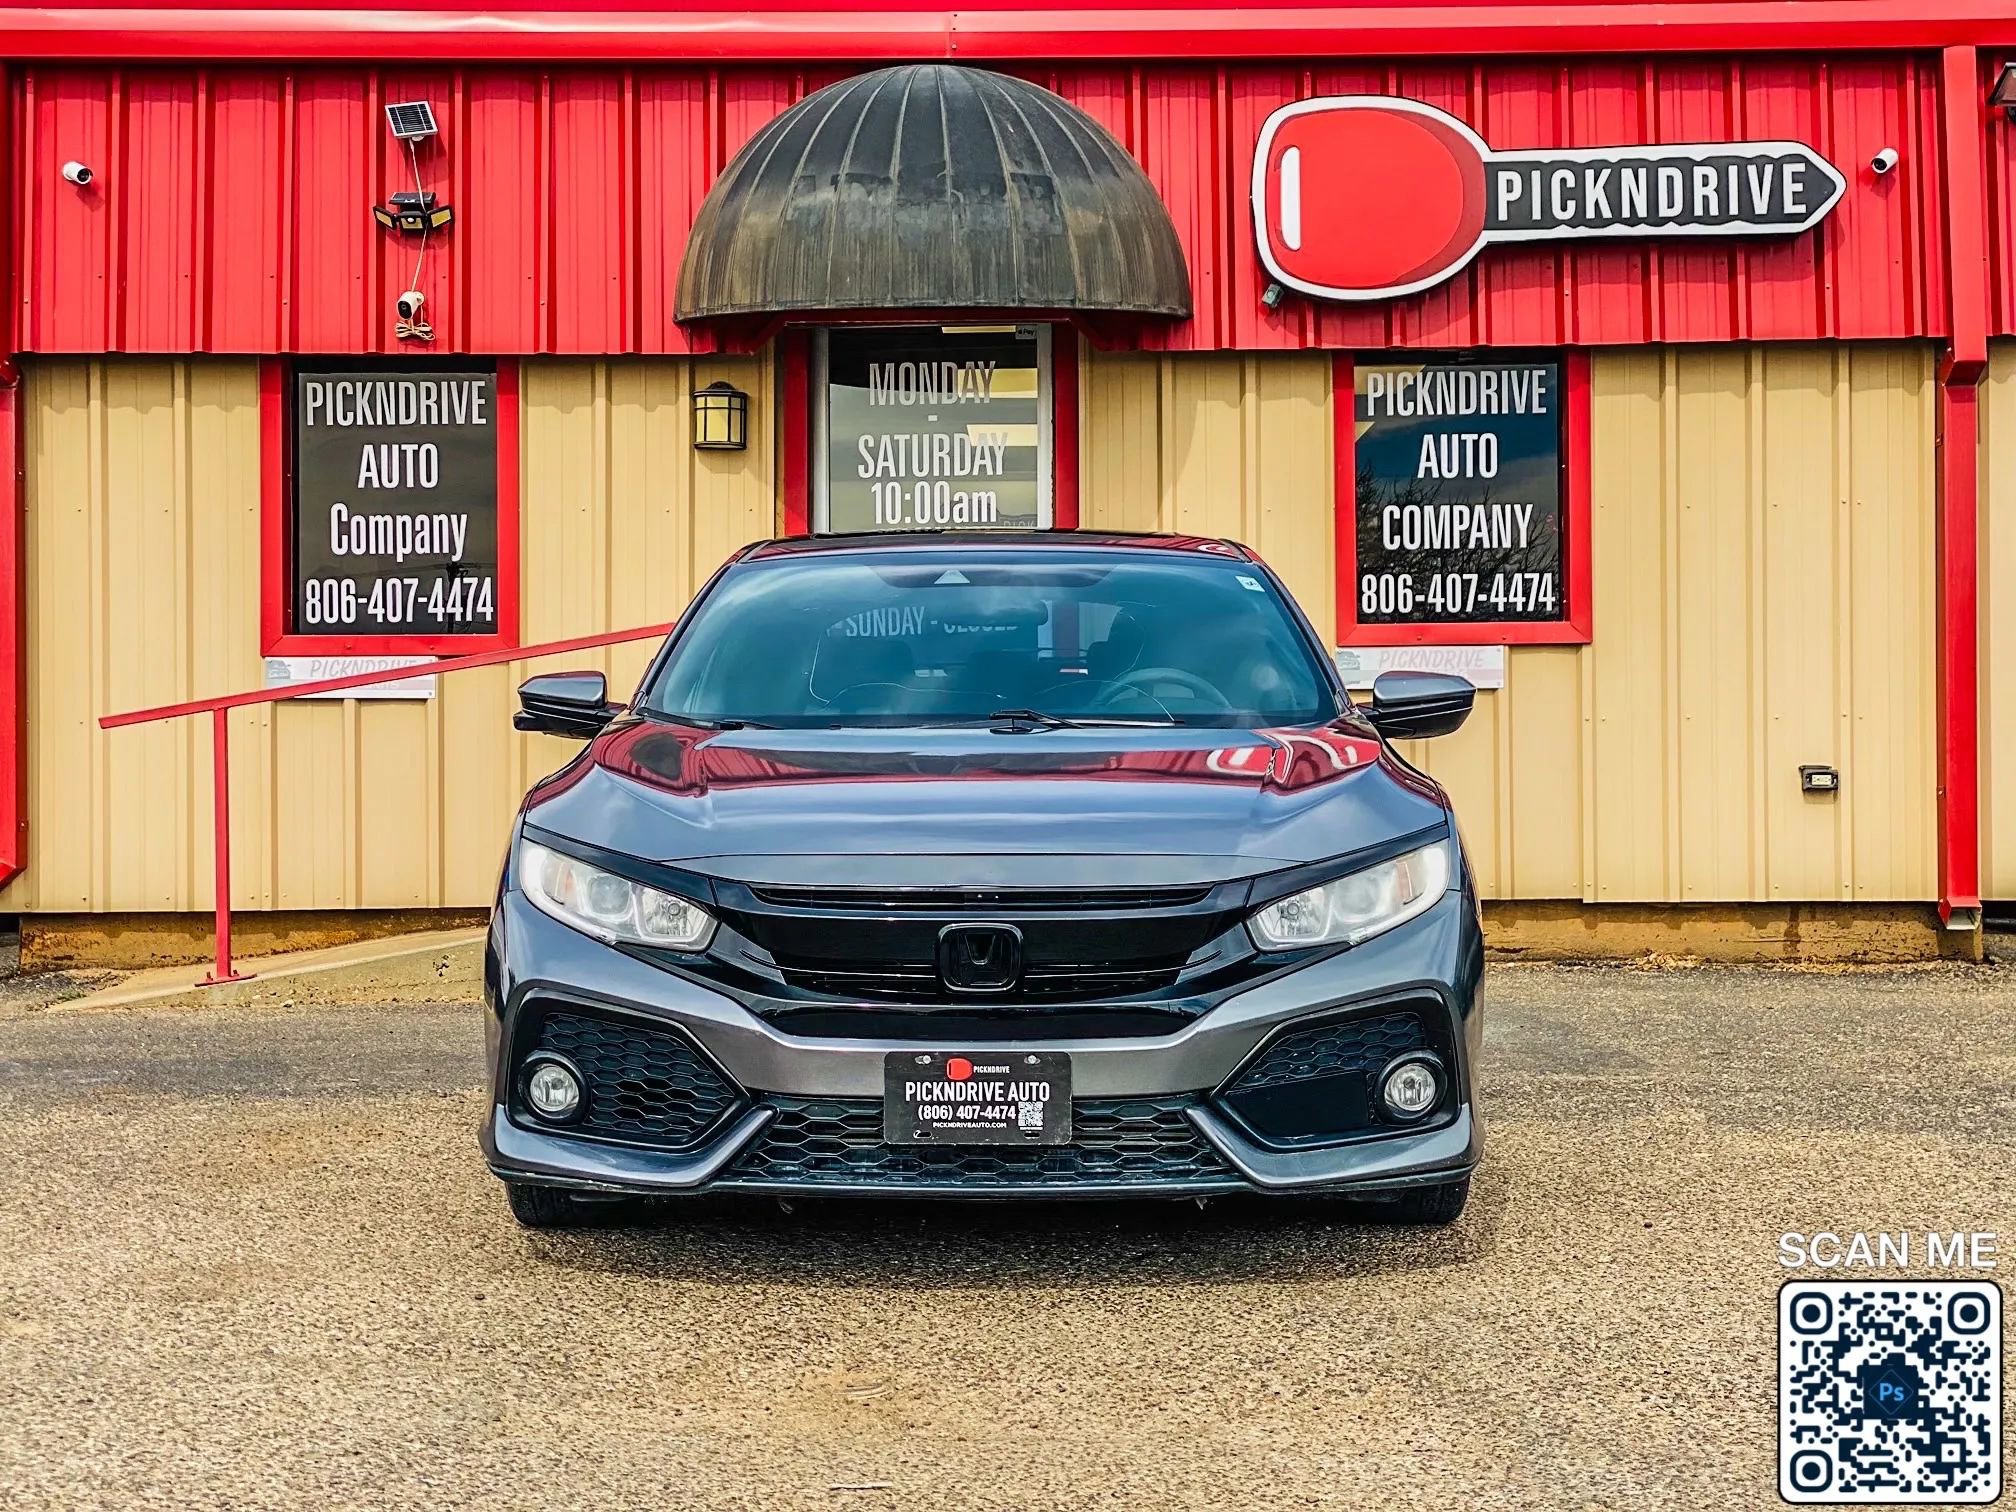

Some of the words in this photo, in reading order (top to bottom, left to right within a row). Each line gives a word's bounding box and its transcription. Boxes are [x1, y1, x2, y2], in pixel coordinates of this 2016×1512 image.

[1497, 162, 1807, 222] PICKNDRIVE
[306, 380, 487, 426] PICKNDRIVE
[869, 360, 996, 406] MONDAY
[1367, 369, 1547, 417] PICKNDRIVE
[357, 443, 439, 489] AUTO
[857, 432, 1009, 479] SATURDAY
[1417, 432, 1498, 479] AUTO
[870, 480, 997, 525] 10:00am
[330, 502, 468, 563] Company
[1382, 503, 1534, 551] COMPANY
[305, 576, 494, 624] 806-407-4474
[1361, 572, 1556, 614] 806-407-4474
[845, 606, 926, 637] SUNDAY
[1378, 649, 1485, 670] PICKNDRIVE
[905, 1081, 1005, 1102] PICKNDRIVE
[1008, 1081, 1050, 1102] AUTO
[973, 1065, 1011, 1074] PICKNDRIVE
[917, 1104, 954, 1121] (806)
[956, 1105, 1017, 1120] 407-4474
